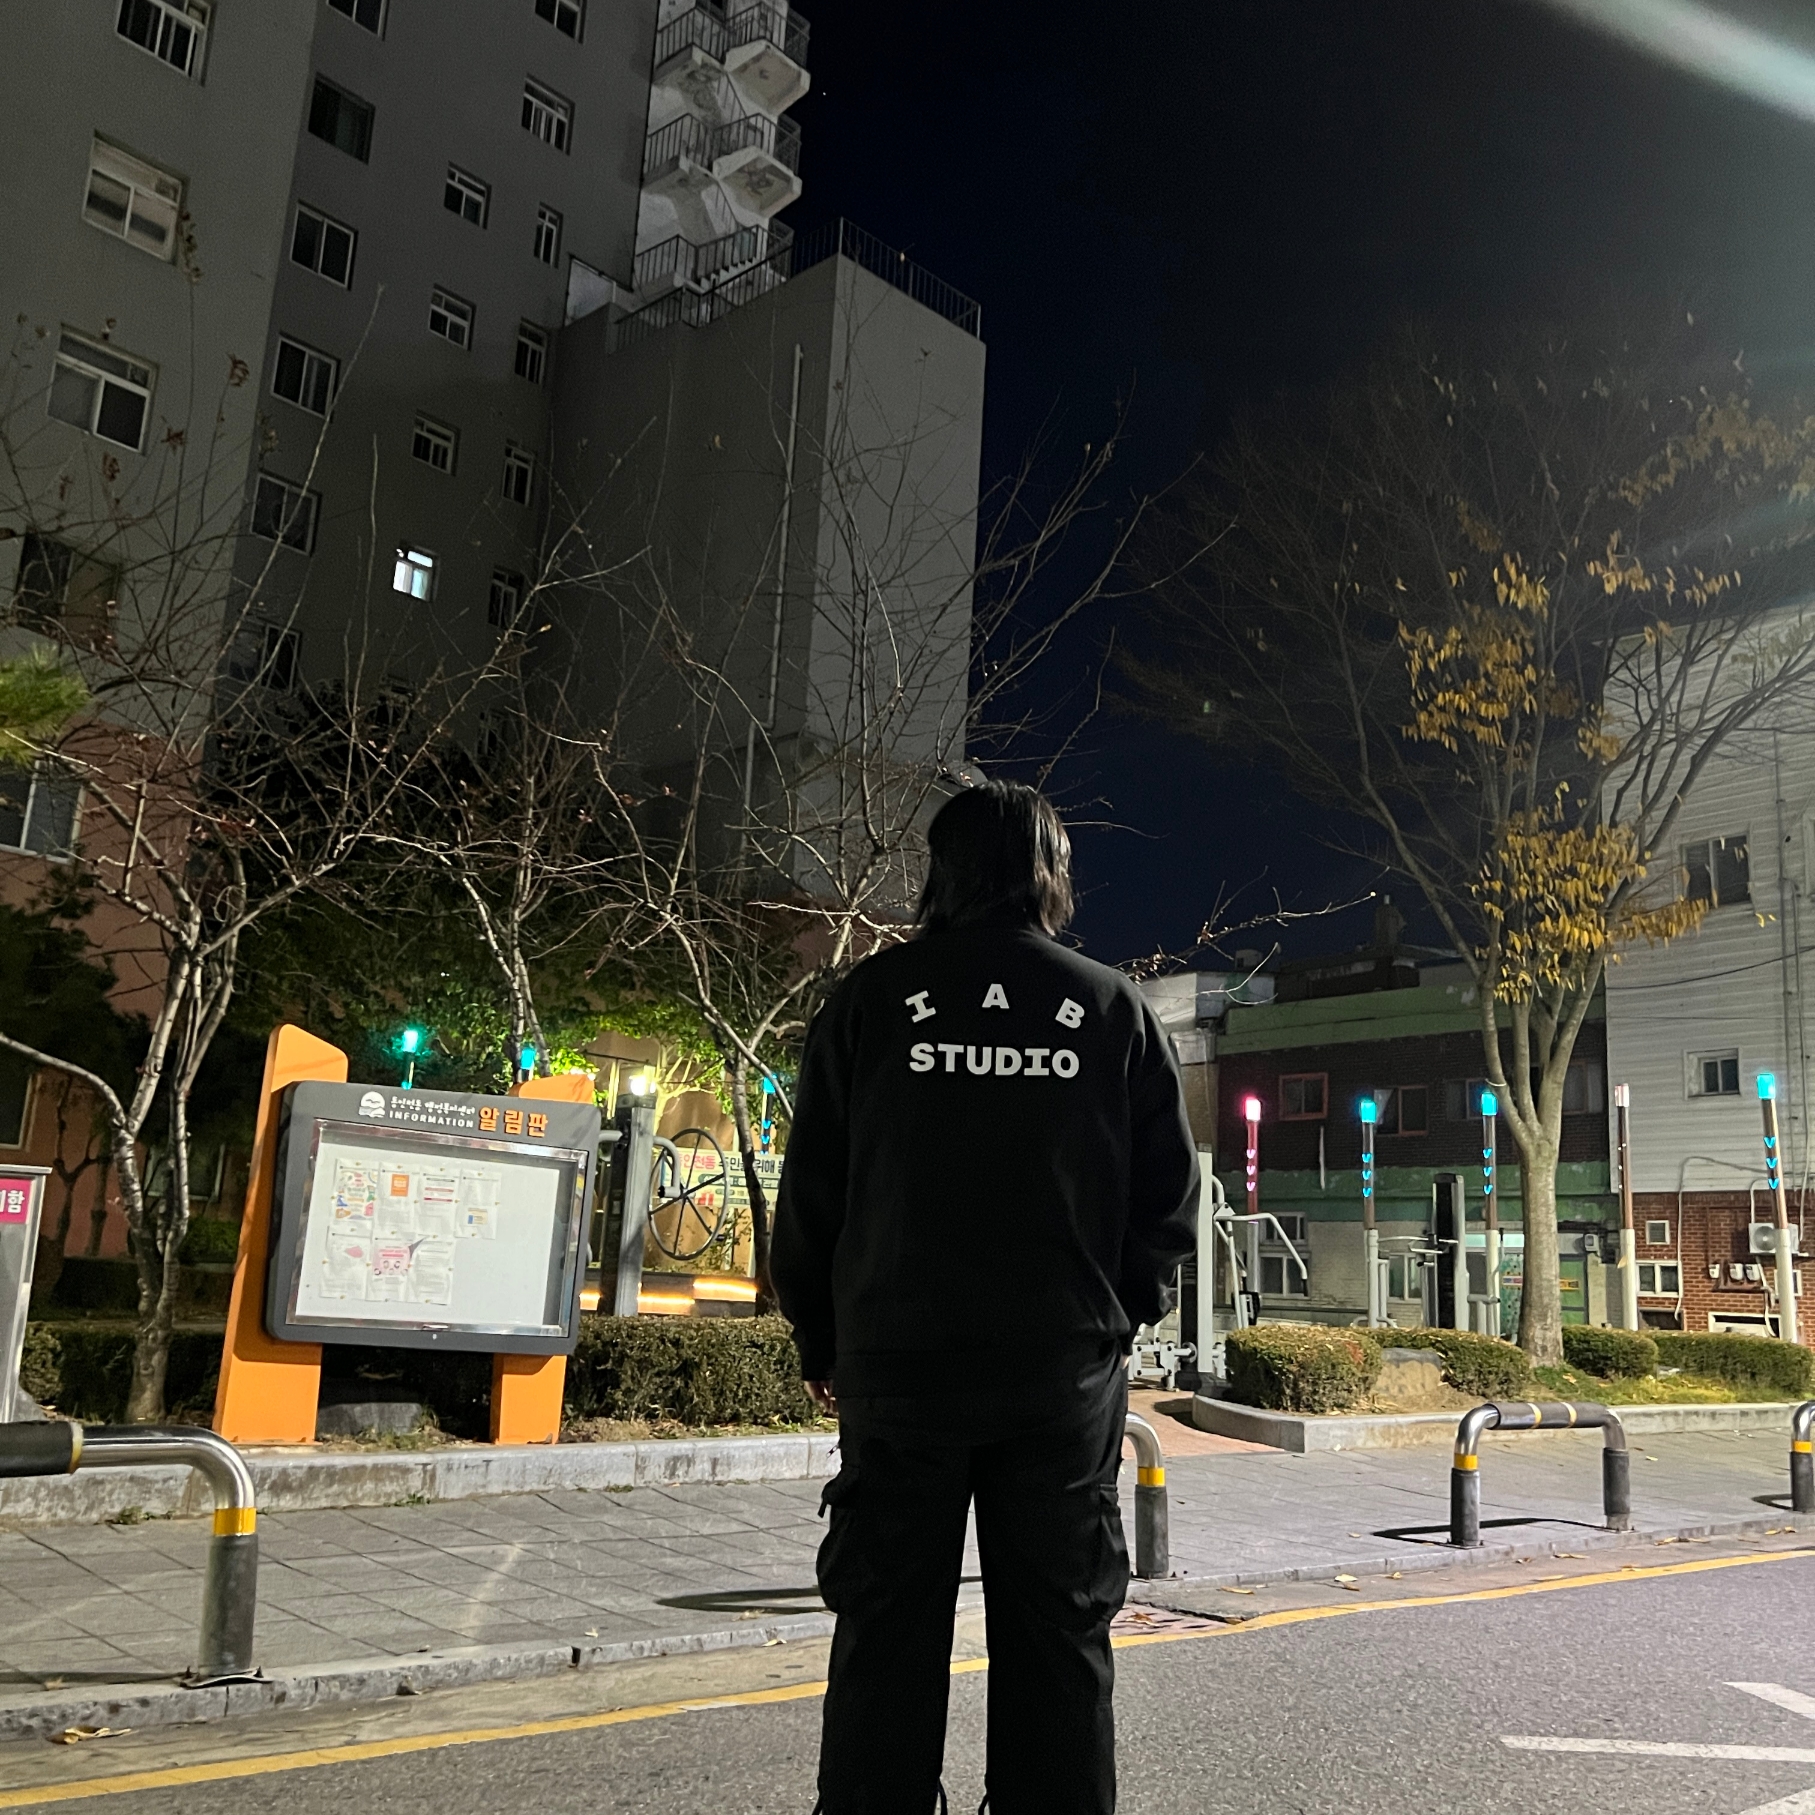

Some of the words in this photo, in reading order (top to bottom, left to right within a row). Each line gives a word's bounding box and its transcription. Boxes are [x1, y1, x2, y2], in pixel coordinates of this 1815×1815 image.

[909, 1042, 1080, 1079] STUDIO
[389, 1110, 474, 1128] INFORMATION
[478, 1106, 549, 1138] 알림판
